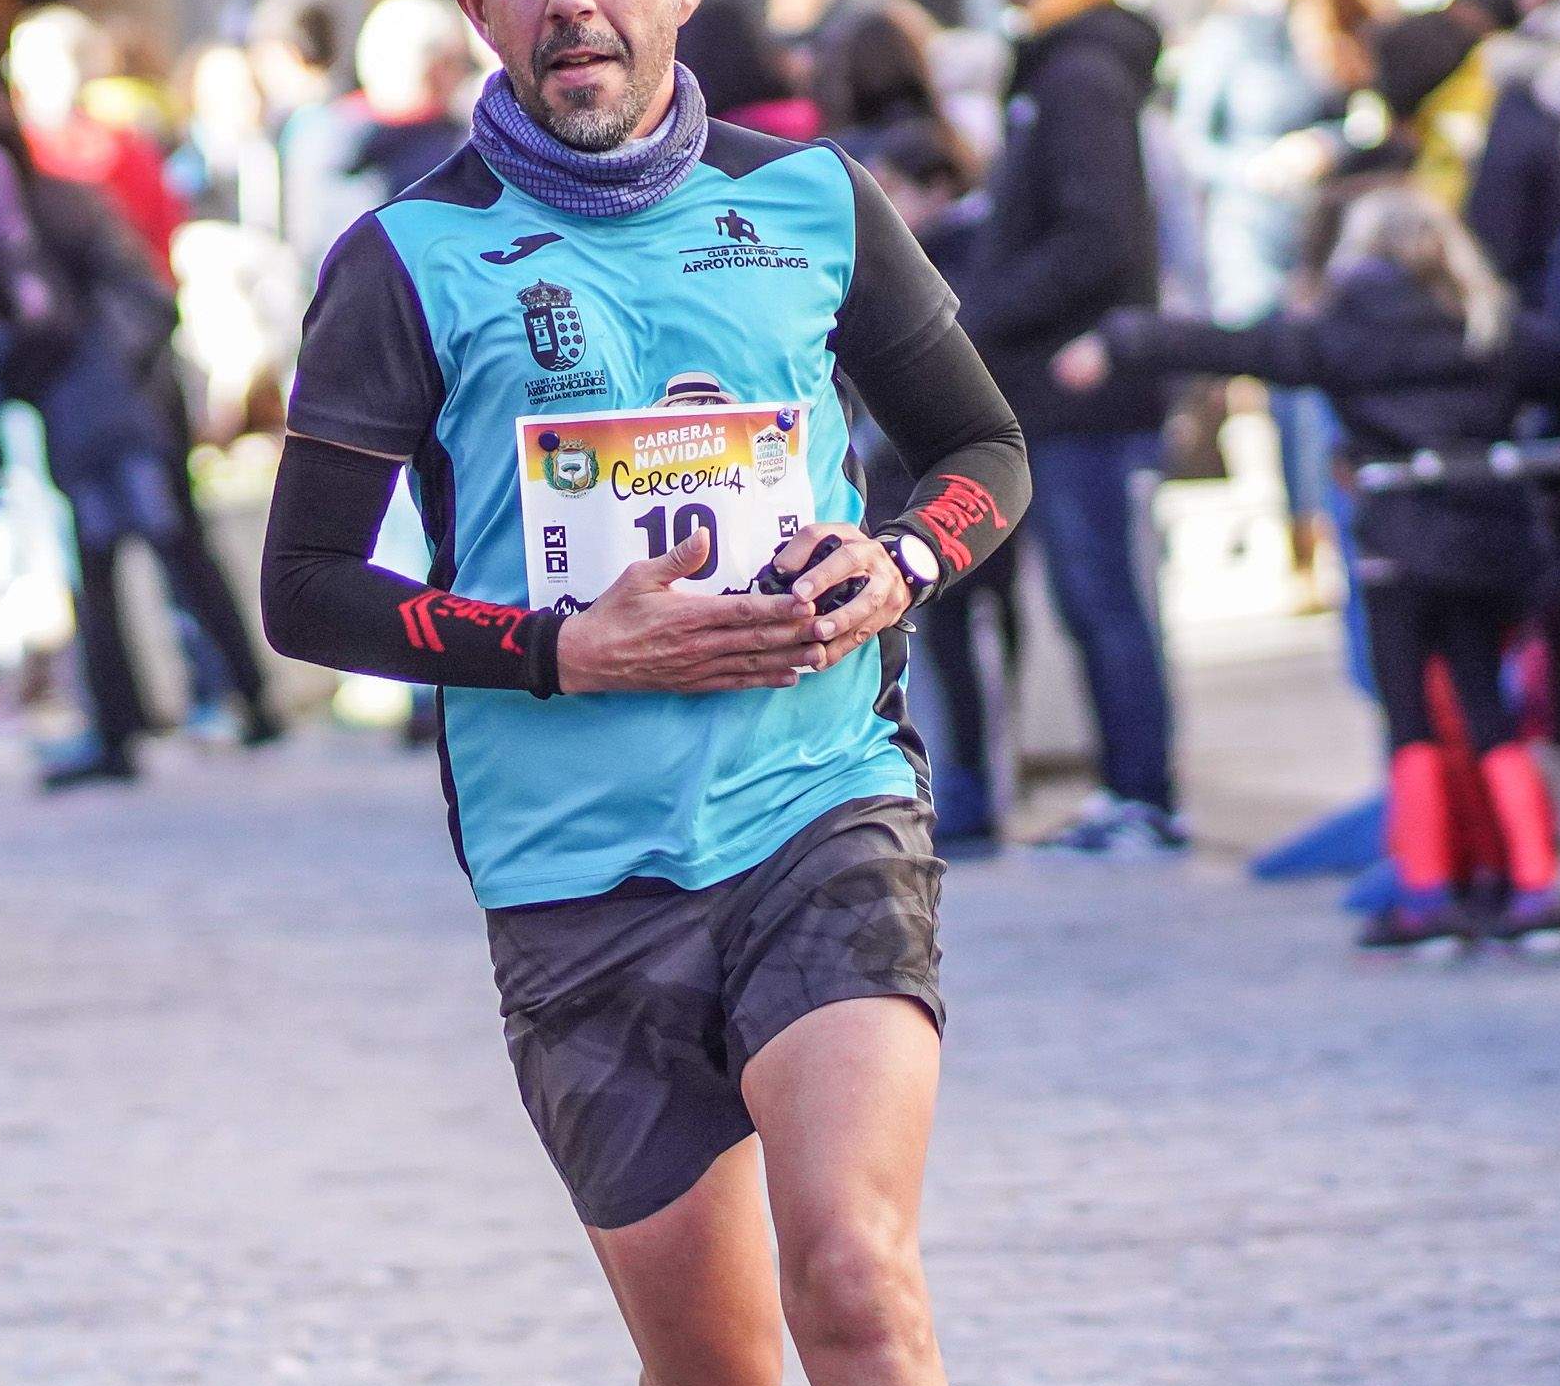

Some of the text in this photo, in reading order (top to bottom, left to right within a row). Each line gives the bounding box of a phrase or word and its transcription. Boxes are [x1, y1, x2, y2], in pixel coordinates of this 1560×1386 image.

[707, 249, 730, 258] CLUB
[683, 256, 809, 273] ARROYOMOLINOS
[524, 371, 592, 388] AYUNTAMIENTO
[634, 423, 726, 451] CARRERA DE
[635, 436, 726, 471] NAVIDAD
